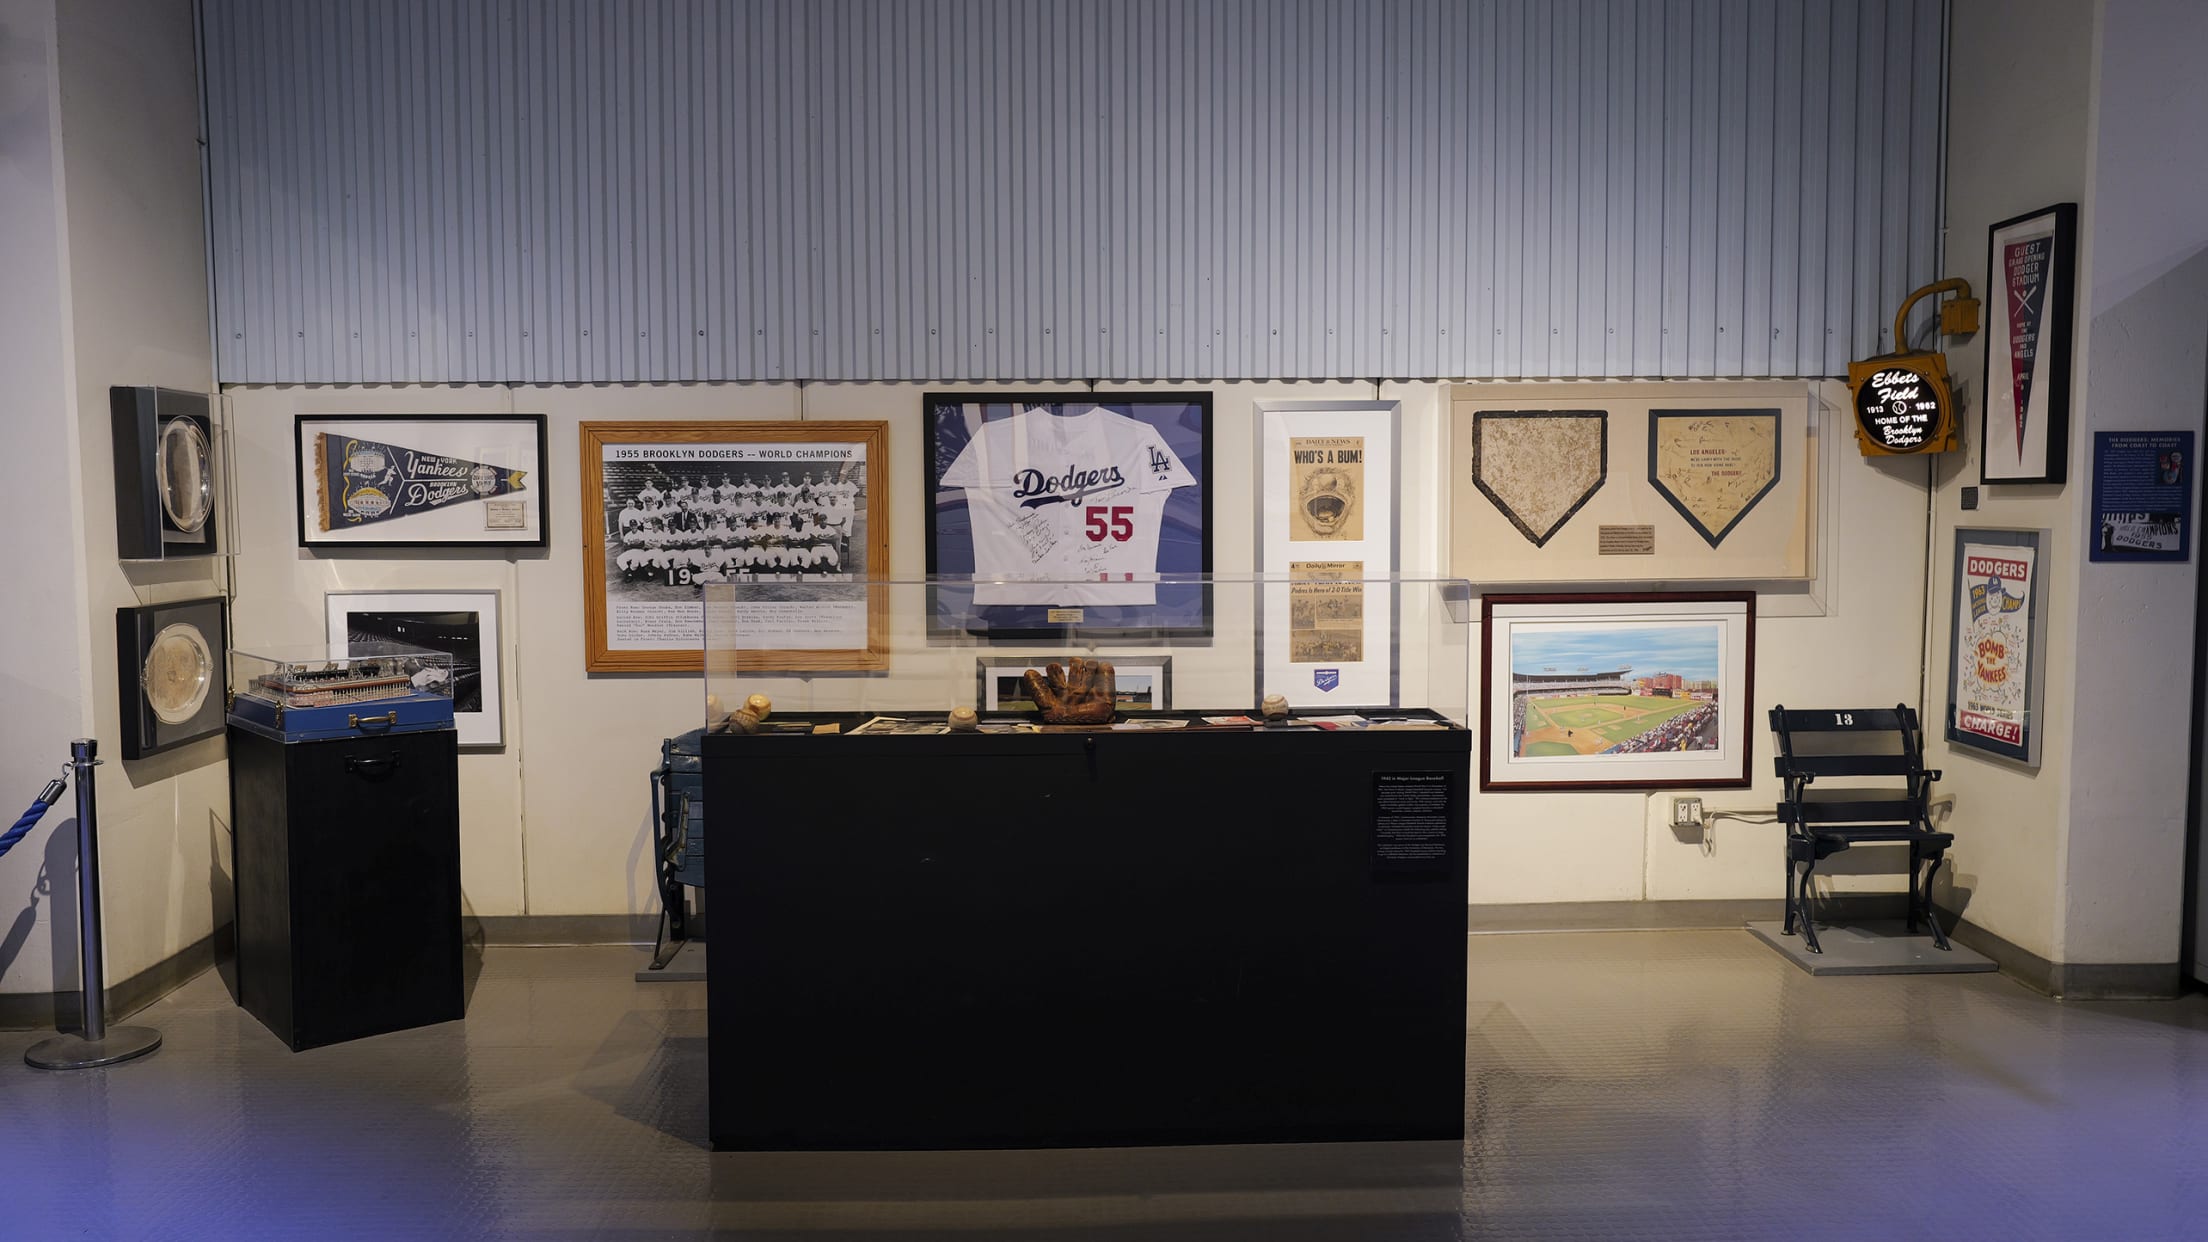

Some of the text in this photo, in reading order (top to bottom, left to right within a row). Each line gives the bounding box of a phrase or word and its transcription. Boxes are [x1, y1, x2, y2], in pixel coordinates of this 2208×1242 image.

[2014, 242, 2041, 258] GUEST
[2024, 252, 2046, 264] OPENING
[2013, 263, 2039, 276] DODGER
[2012, 272, 2040, 288] STADIUM
[2013, 333, 2036, 344] DODGERS
[1872, 370, 1920, 388] Ebbets
[1877, 386, 1919, 404] Field
[1875, 414, 1928, 425] HOME OF THE
[1883, 424, 1923, 436] Brooklyn
[1885, 434, 1923, 447] Dodgers
[440, 457, 457, 465] YORK
[616, 450, 640, 458] 1955
[643, 450, 695, 458] BROOKLYN
[699, 450, 744, 458] DODGERS
[759, 450, 793, 458] WORLD
[796, 450, 852, 459] CHAMPIONS
[1148, 446, 1170, 472] LA
[1294, 450, 1363, 464] WHO'S A BUM!
[404, 451, 468, 479] Yankees
[1013, 464, 1125, 508] Dodgers
[404, 483, 469, 507] Dodgers
[1085, 506, 1133, 541] 55
[2116, 535, 2162, 549] DODGERS
[1970, 559, 2026, 578] DODGERS
[669, 568, 692, 586] 19
[1978, 639, 2005, 659] BOMB
[1986, 657, 1996, 665] THE
[1977, 661, 2007, 684] YANKEES
[1834, 713, 1854, 726] 13
[1964, 715, 2019, 740] CHARGE!
